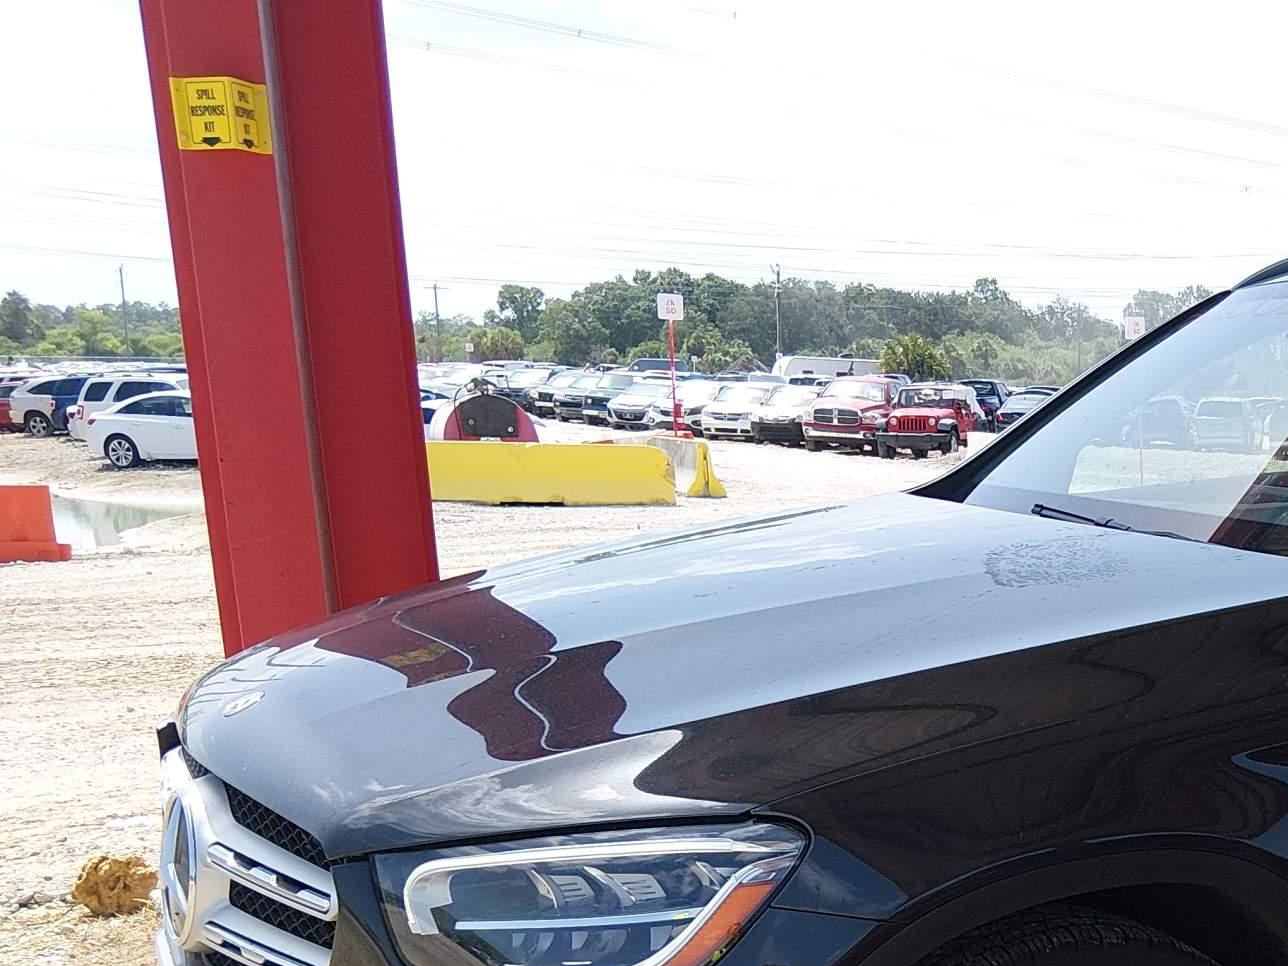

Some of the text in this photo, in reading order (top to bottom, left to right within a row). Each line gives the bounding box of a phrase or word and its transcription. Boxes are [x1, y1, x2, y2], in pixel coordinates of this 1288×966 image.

[196, 88, 216, 100] SPILL
[190, 104, 225, 117] RESPONSE
[203, 121, 215, 133] KIT
